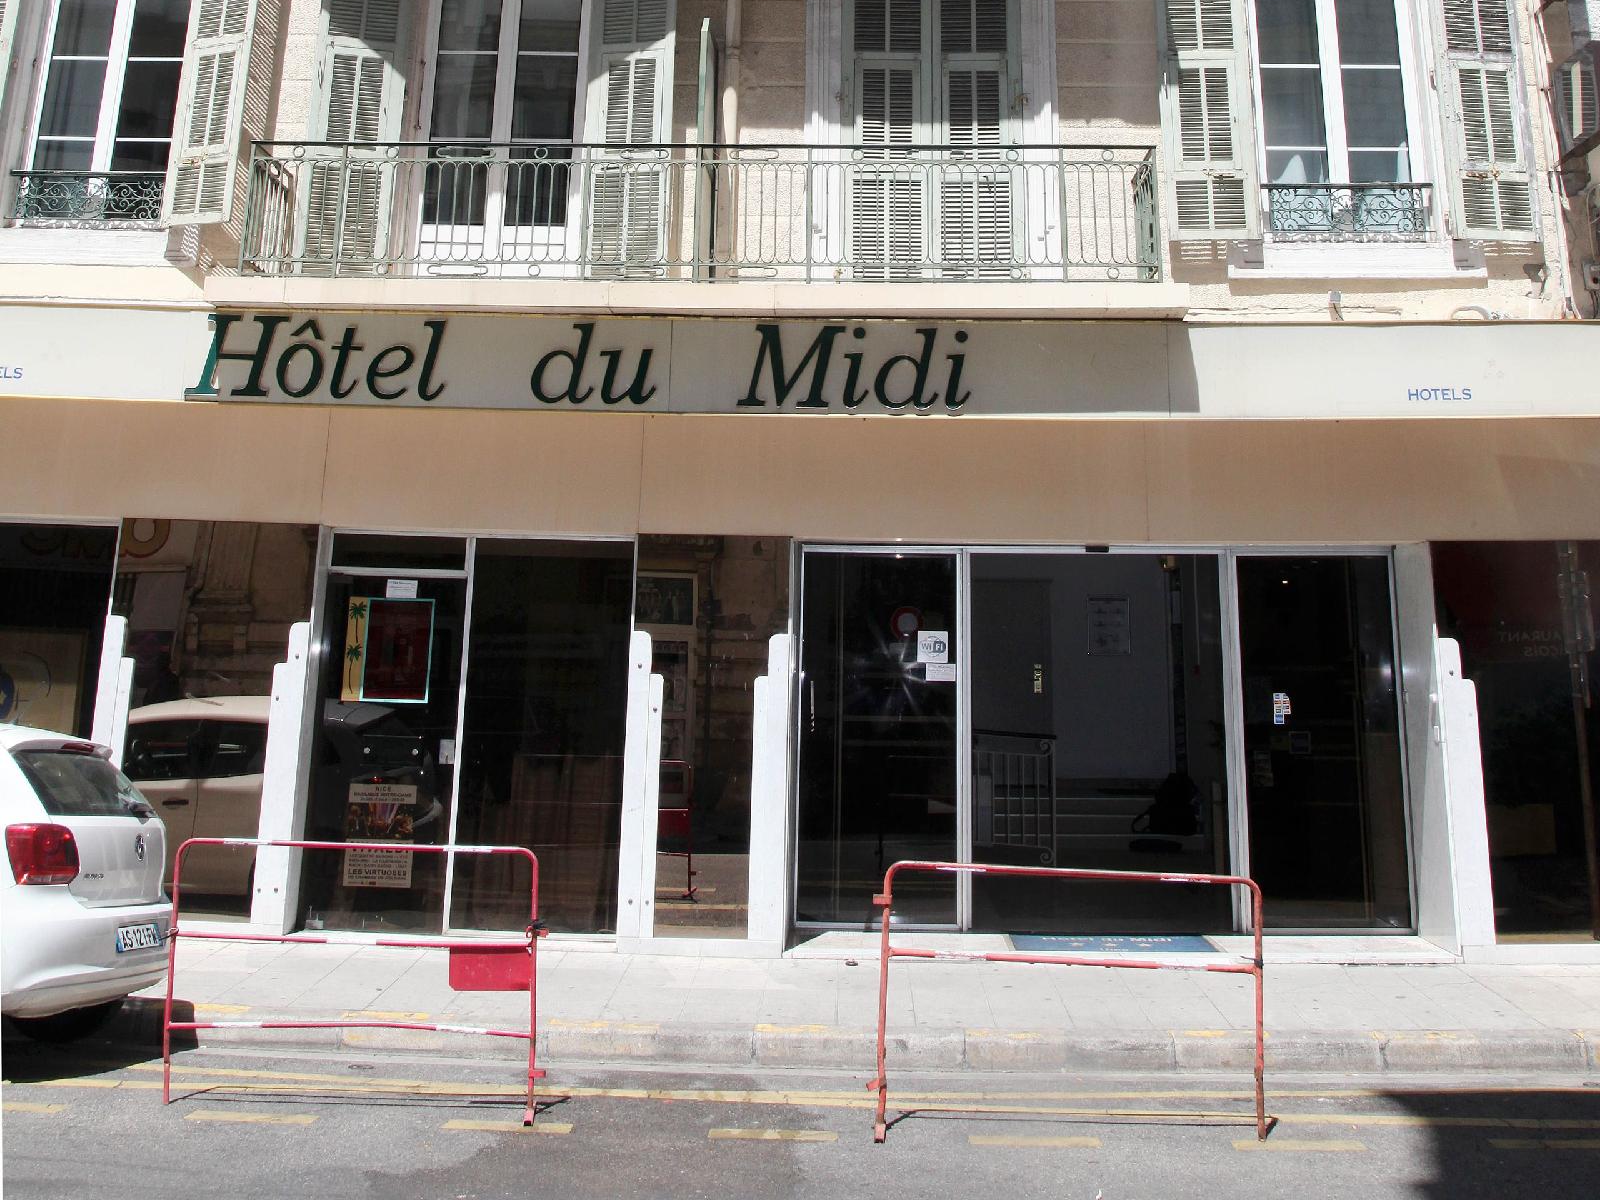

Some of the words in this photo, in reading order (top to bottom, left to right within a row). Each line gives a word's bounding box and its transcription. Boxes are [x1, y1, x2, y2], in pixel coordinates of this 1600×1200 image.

[184, 313, 446, 403] Hôtel
[530, 322, 658, 405] du
[737, 323, 972, 410] Midi
[1407, 388, 1472, 401] HOTELS
